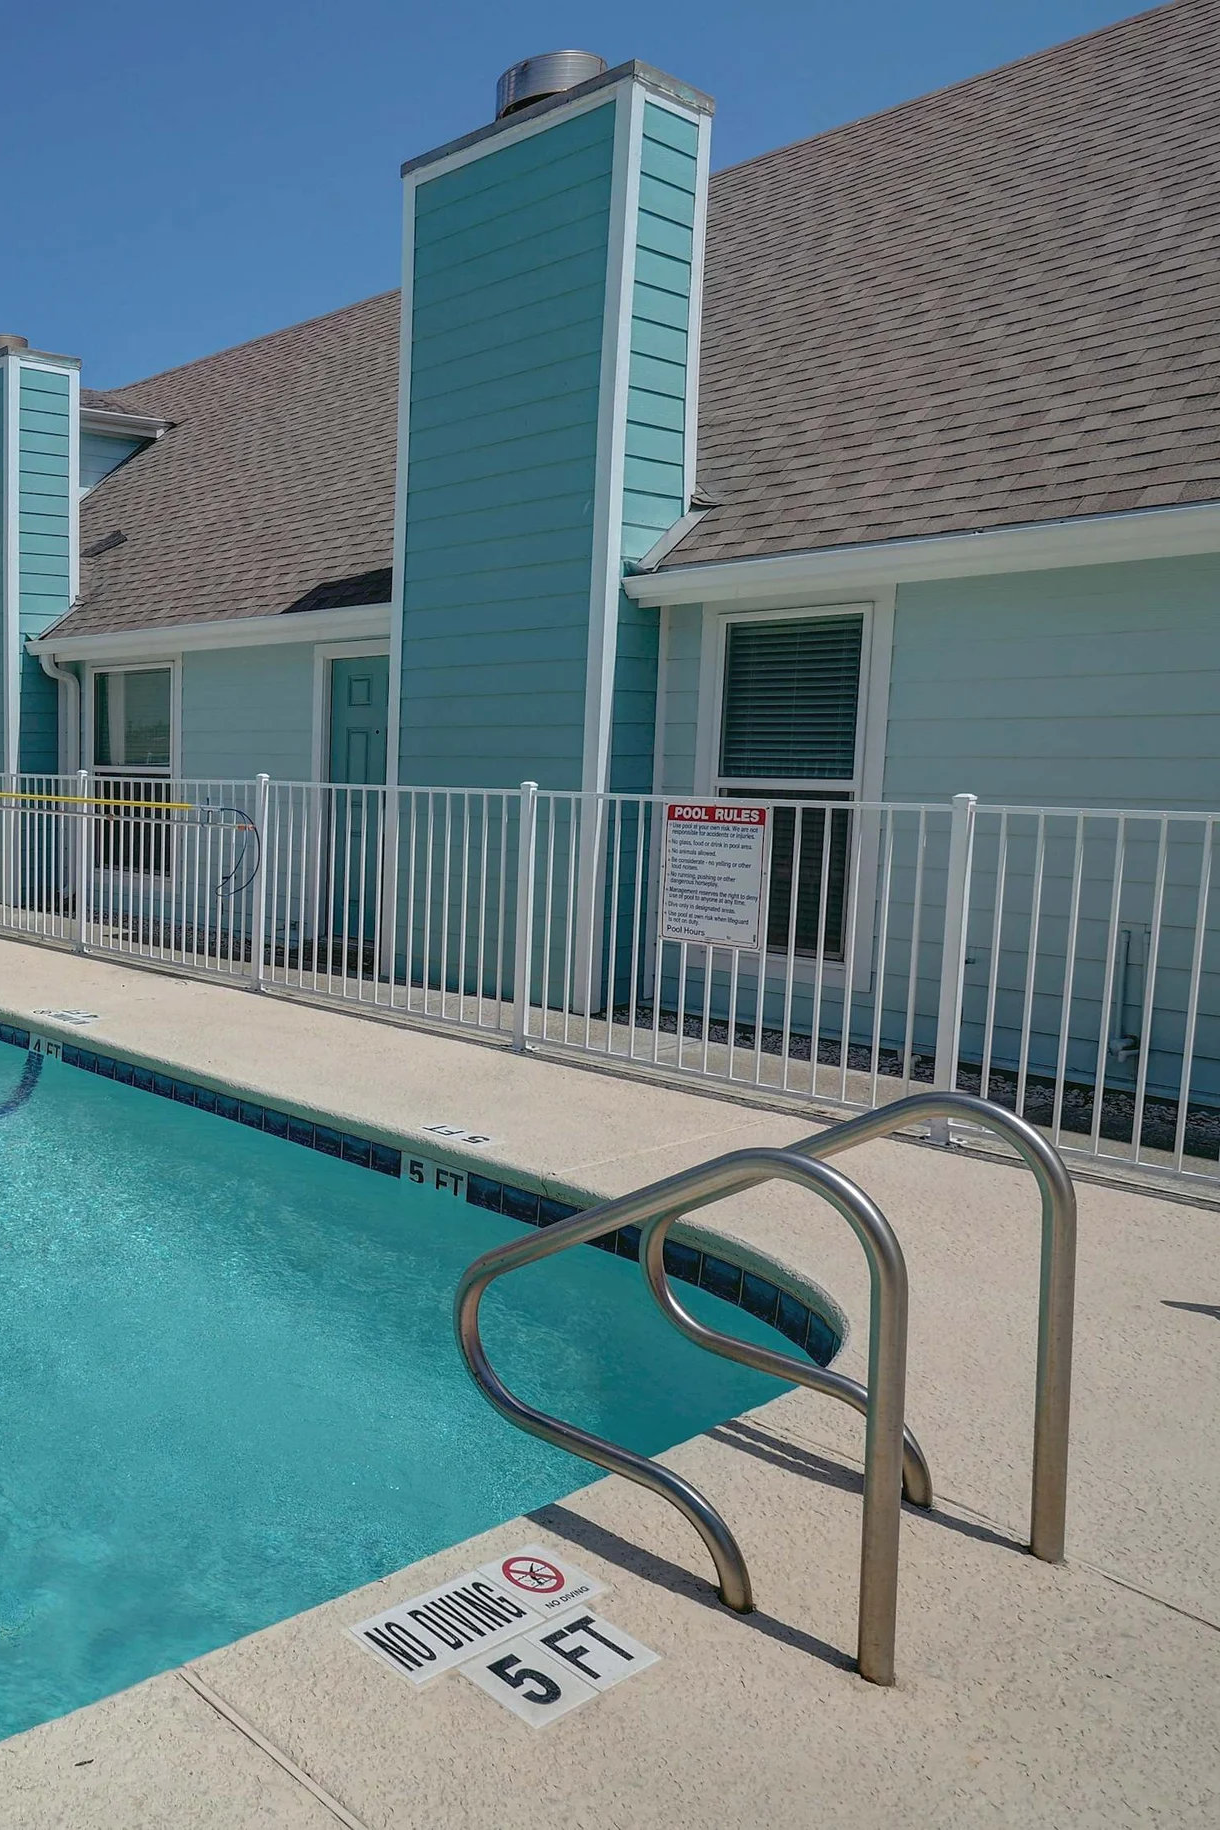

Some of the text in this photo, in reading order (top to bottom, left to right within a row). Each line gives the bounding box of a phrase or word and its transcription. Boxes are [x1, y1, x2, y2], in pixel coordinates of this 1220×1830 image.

[674, 806, 760, 822] POOL RULES
[695, 880, 719, 889] horseplay.
[669, 886, 698, 894] Management
[746, 894, 758, 903] deny
[727, 916, 749, 925] lifeguard
[667, 924, 705, 936] Pool Hours
[46, 1042, 61, 1060] FT
[422, 1125, 490, 1144] 5 FT
[409, 1160, 464, 1196] 5 FT
[544, 1585, 590, 1610] NO DIVING
[363, 1581, 528, 1672] NO DIVING
[486, 1615, 635, 1705] 5 FT
